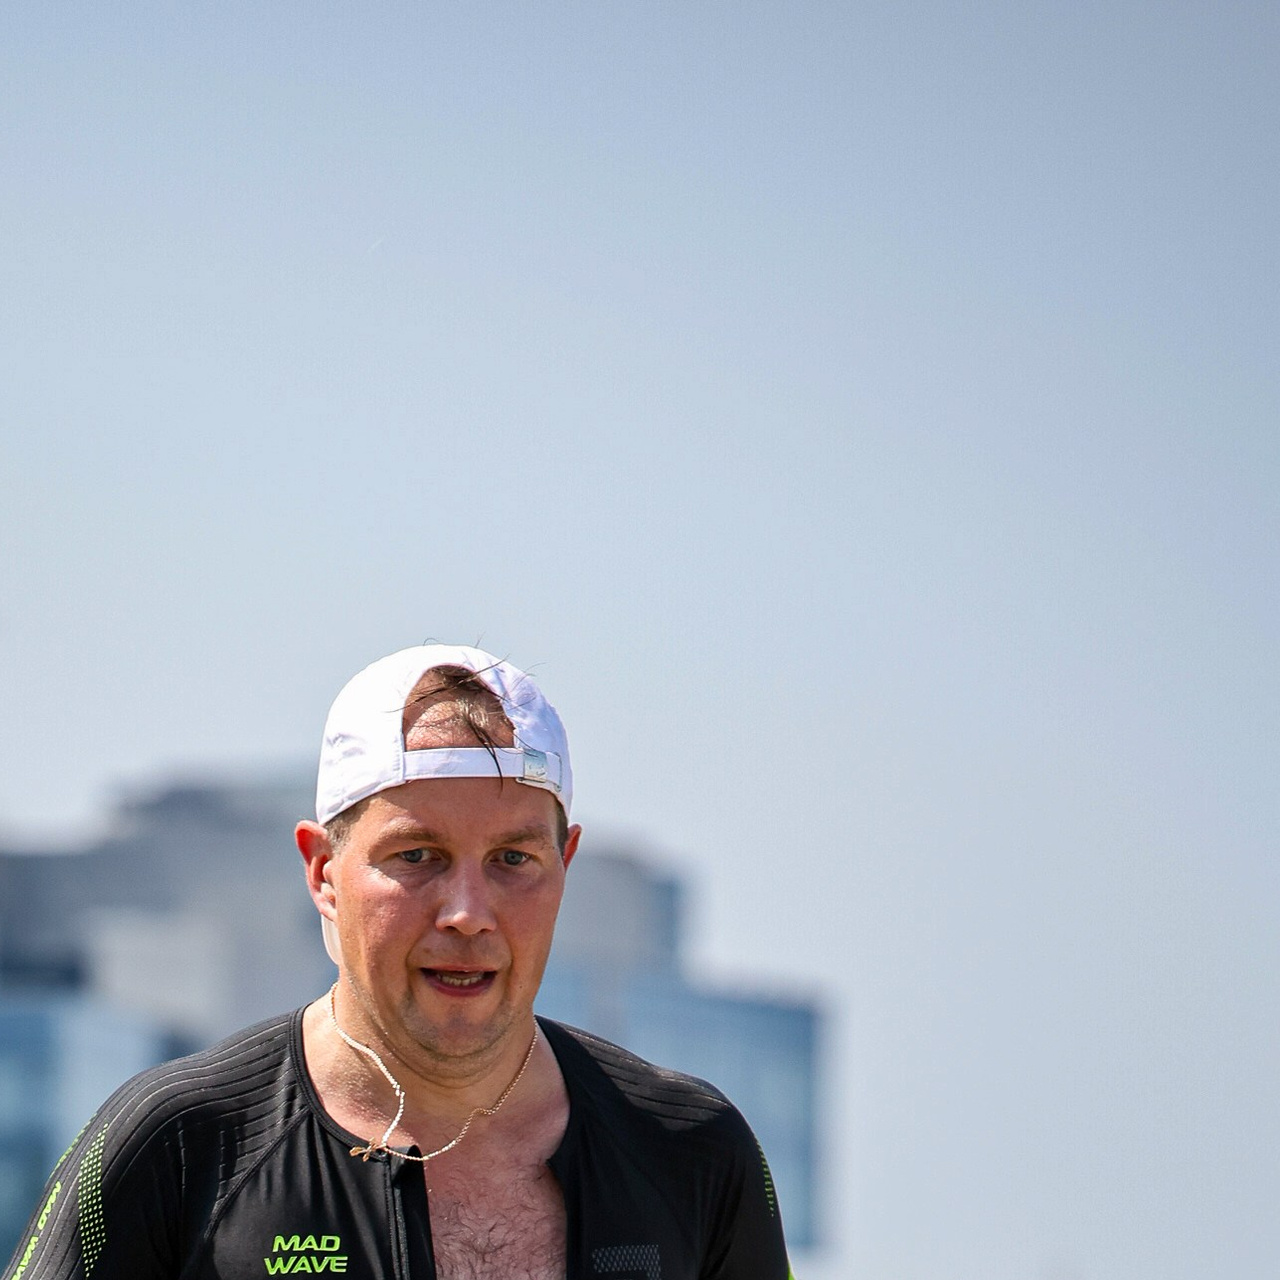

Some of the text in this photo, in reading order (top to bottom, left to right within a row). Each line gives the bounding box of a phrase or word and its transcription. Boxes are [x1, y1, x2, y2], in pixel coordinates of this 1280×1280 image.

[38, 1181, 61, 1230] MAD
[271, 1234, 341, 1252] MAD
[263, 1255, 348, 1275] WAVE
